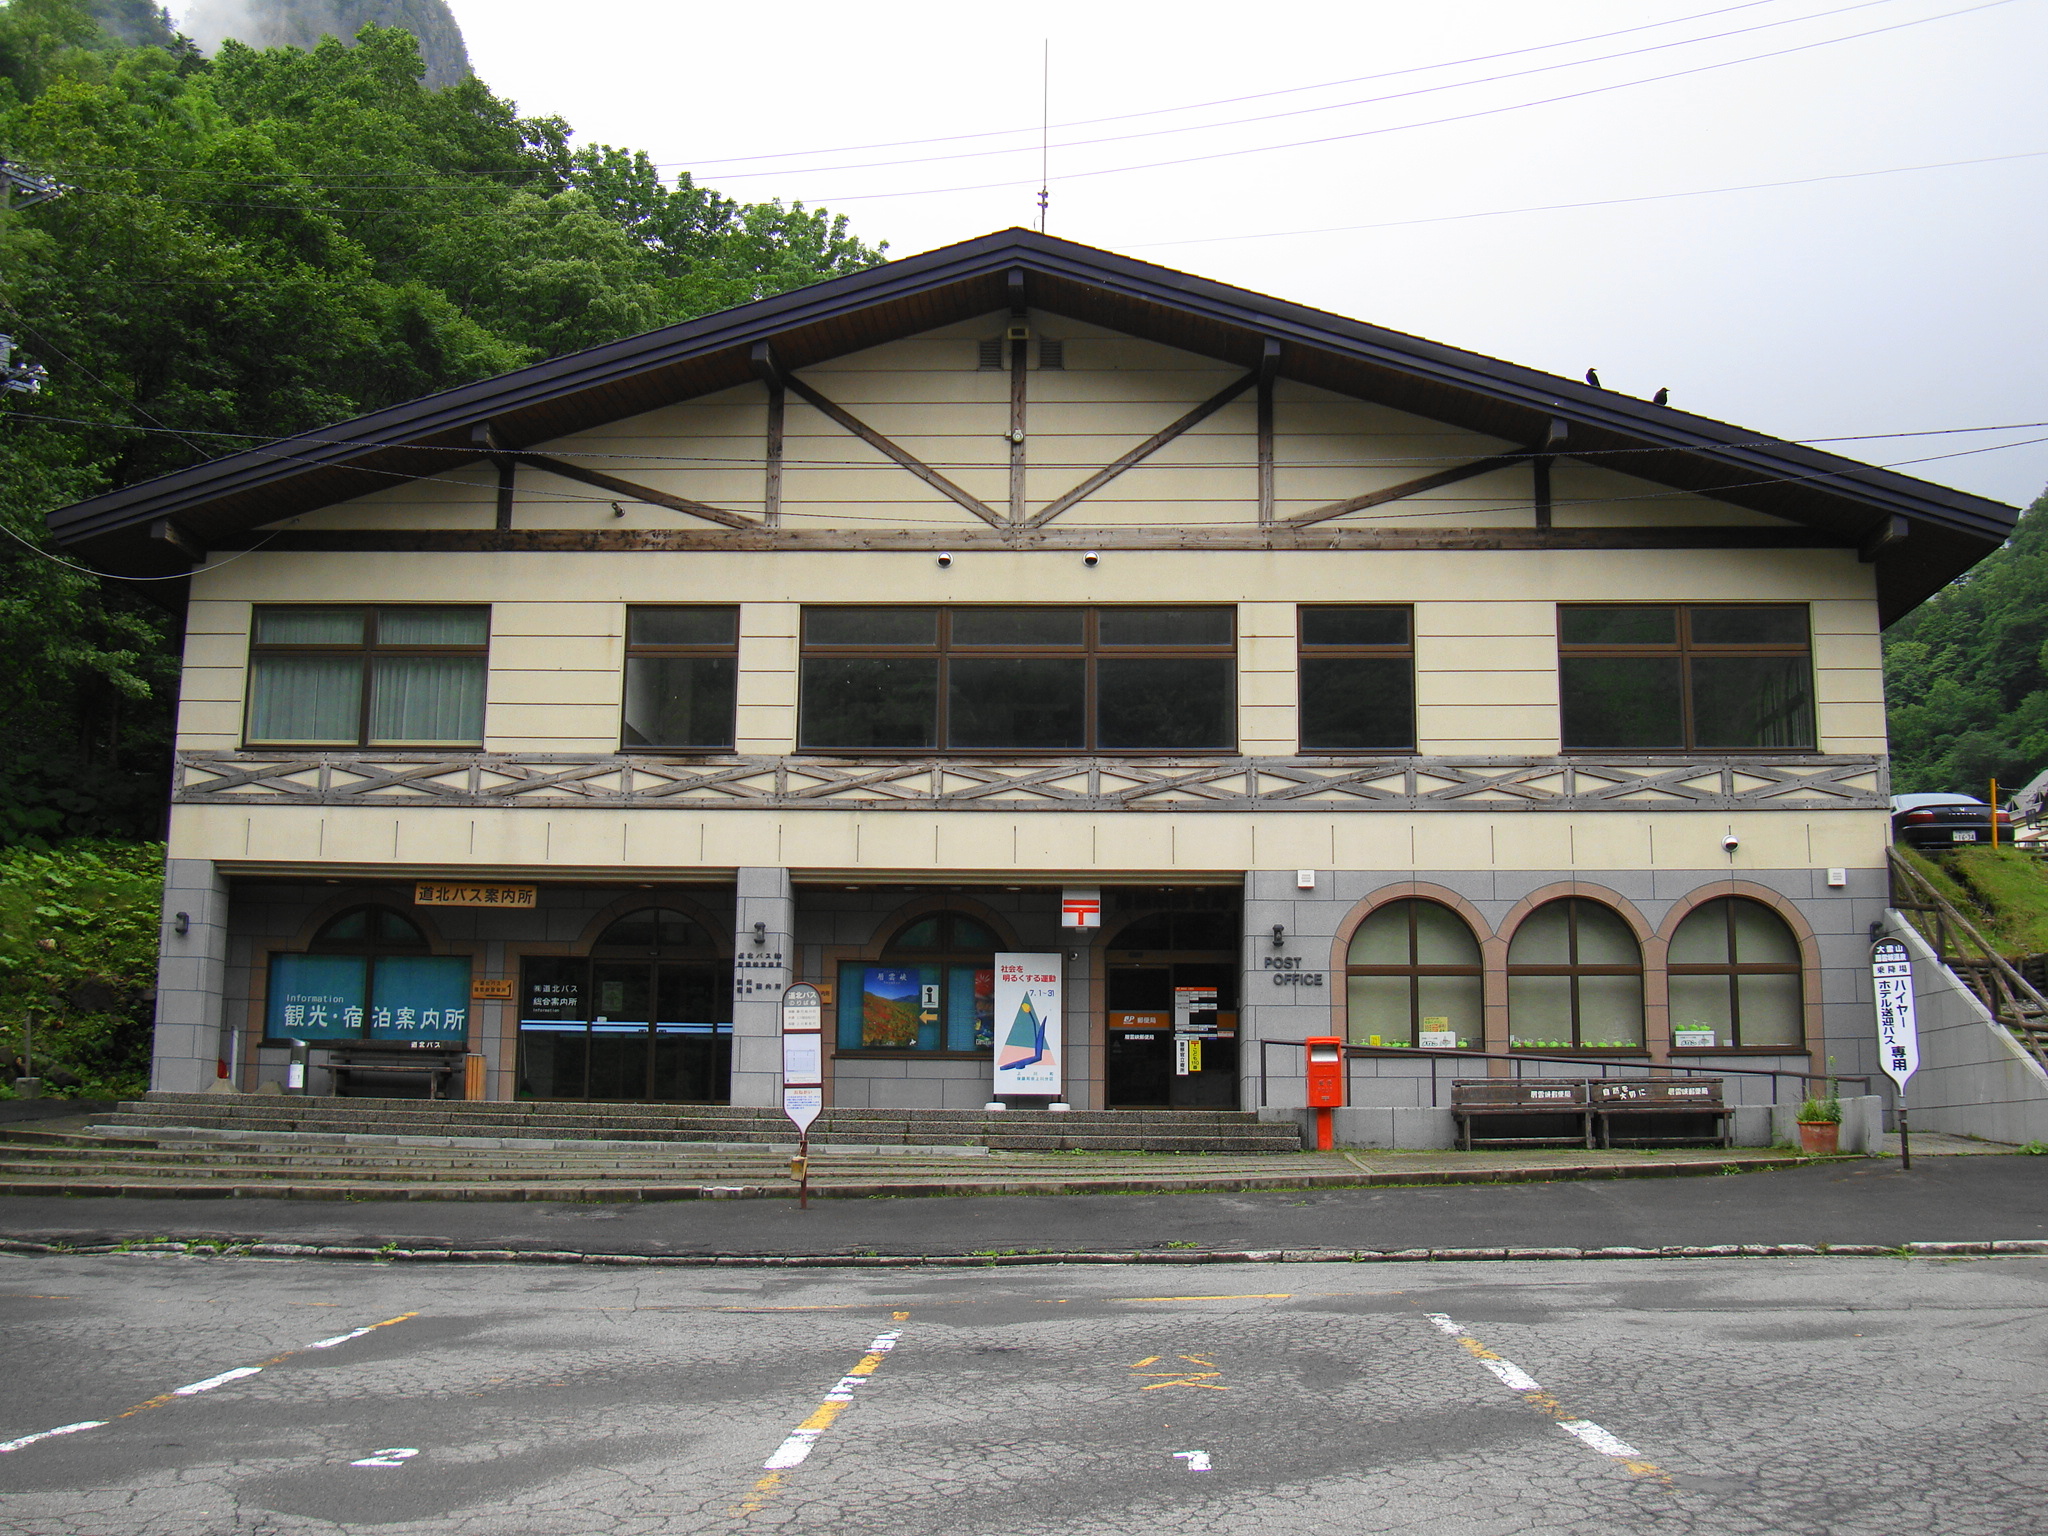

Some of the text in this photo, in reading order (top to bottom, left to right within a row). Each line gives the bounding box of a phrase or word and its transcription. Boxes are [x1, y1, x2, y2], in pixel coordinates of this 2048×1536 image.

[419, 886, 533, 904] 道北バス案内所
[1876, 944, 1904, 954] 大雪山
[1001, 965, 1023, 973] 社会を
[1264, 956, 1302, 969] POST
[1877, 964, 1908, 974] 乗降場
[1002, 974, 1056, 982] 明るくする運動
[1273, 973, 1323, 986] OFFICE
[286, 993, 344, 1003] Information
[533, 997, 578, 1006] 総合案内所
[788, 991, 817, 999] 道北バス
[1895, 979, 1908, 1028] ハイヤー
[284, 1004, 465, 1031] 観光・宿泊案内所
[1878, 980, 1896, 1045] ホテル送迎バス
[1891, 1045, 1907, 1071] 専用
[350, 1447, 420, 1468] 2
